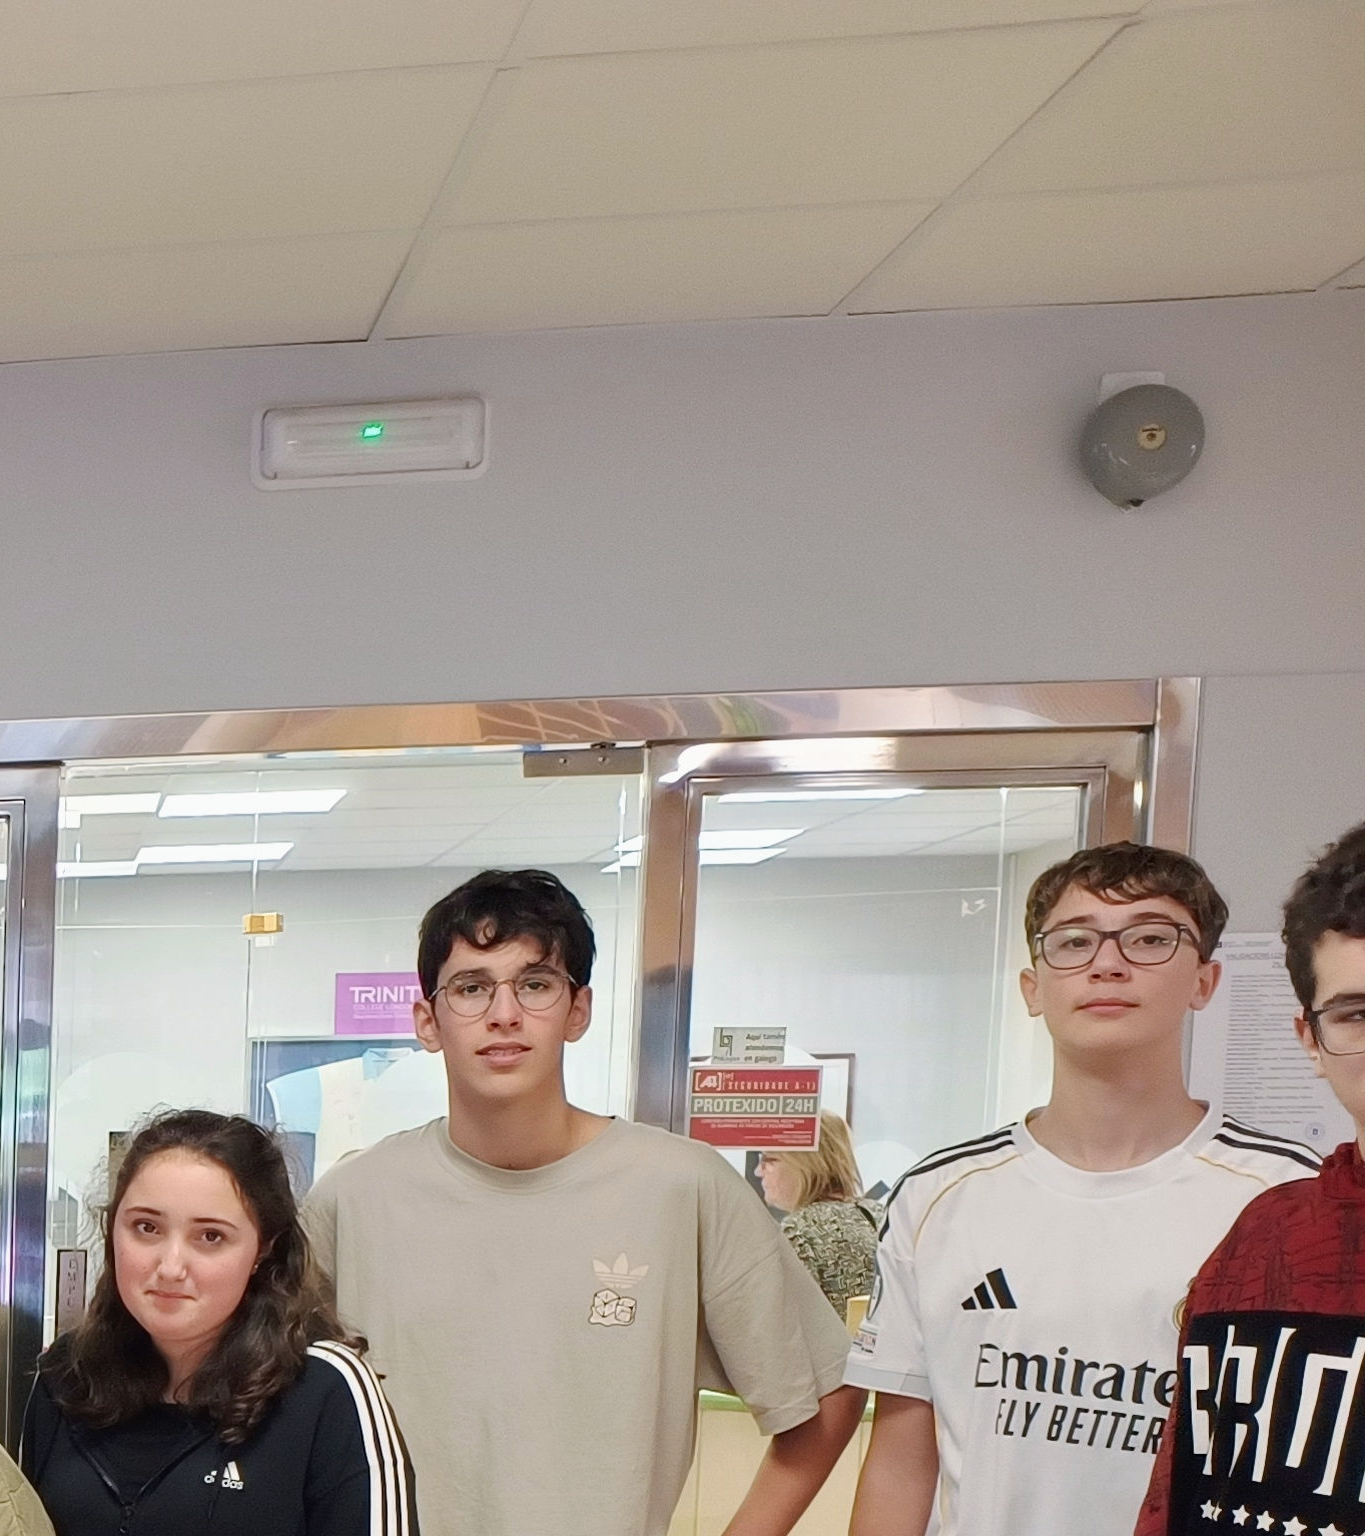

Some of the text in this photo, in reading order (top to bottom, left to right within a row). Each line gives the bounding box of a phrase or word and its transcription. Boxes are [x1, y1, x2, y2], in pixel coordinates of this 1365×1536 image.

[349, 985, 422, 1003] TRINIT
[693, 1098, 814, 1113] PROTEXIDO 24H
[973, 1342, 1180, 1408] Emirate
[1046, 1404, 1167, 1455] BETTER
